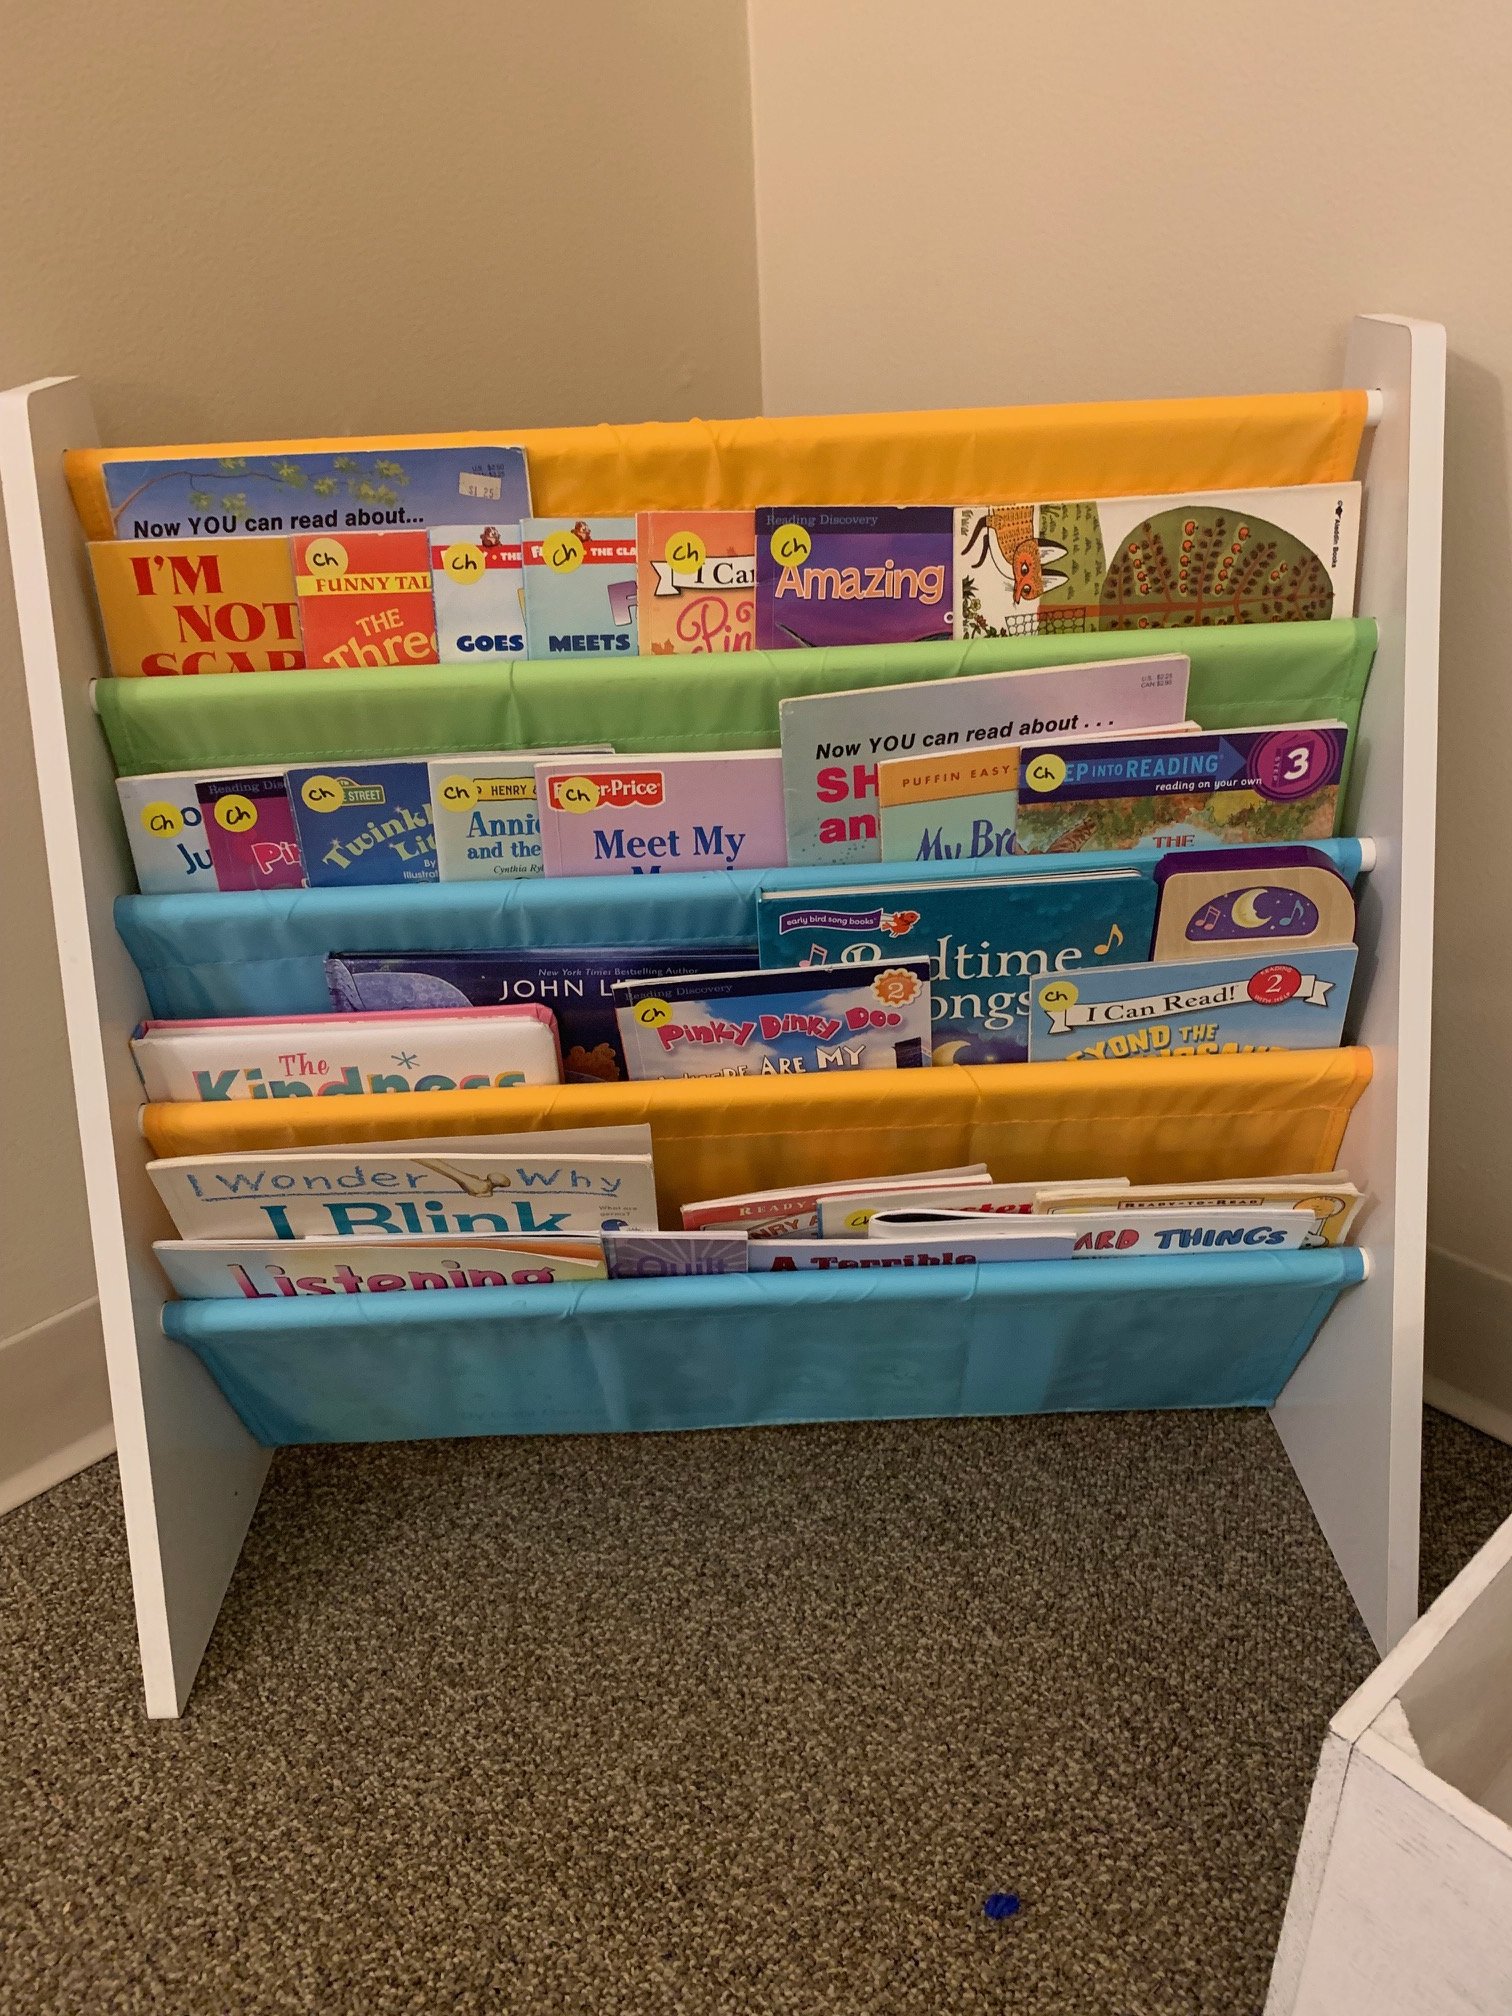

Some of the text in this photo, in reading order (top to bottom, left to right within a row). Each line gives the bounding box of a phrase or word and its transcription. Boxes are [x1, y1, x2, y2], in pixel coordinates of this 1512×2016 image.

[134, 520, 181, 539] Now
[188, 516, 237, 535] YOU
[245, 516, 283, 532] can
[290, 509, 338, 530] read
[767, 514, 879, 528] Reading Discovery
[590, 547, 613, 557] THE
[129, 555, 224, 596] I'M
[315, 576, 391, 593] FUNNY
[775, 559, 946, 605] Amazing
[172, 602, 299, 643] NOT
[355, 608, 404, 637] THE
[456, 634, 525, 653] GOES
[549, 633, 631, 653] MEETS
[815, 742, 862, 760] Now
[869, 733, 916, 754] YOU
[922, 731, 959, 747] can
[965, 721, 1014, 742] read
[1092, 763, 1124, 779] INTO
[1126, 754, 1219, 780] READING
[1284, 747, 1310, 780] 3
[902, 771, 961, 788] PUFFIN
[1155, 777, 1263, 793] reading on your own
[348, 789, 381, 801] STREET
[491, 784, 527, 796] HENRY
[467, 841, 541, 860] and the
[593, 825, 746, 862] Meet My
[424, 859, 436, 869] By
[493, 865, 527, 875] Cynthia
[786, 915, 874, 926] early bird song books
[538, 966, 699, 977] New York Times Bestselling Author
[499, 979, 584, 1000] JOHN
[676, 984, 733, 996] Discovery
[887, 982, 905, 999] 2
[1265, 974, 1283, 994] 2
[1086, 986, 1236, 1022] I Can Read!
[656, 1020, 757, 1052] Pinky
[759, 1012, 842, 1041] Dinky
[1179, 1023, 1219, 1043] THE
[279, 1052, 330, 1077] The
[760, 1054, 804, 1076] ARE
[816, 1044, 866, 1069] MY
[187, 1166, 622, 1198] I Wonder Why
[260, 1200, 572, 1240] I Blink
[1154, 1226, 1289, 1250] THINGS
